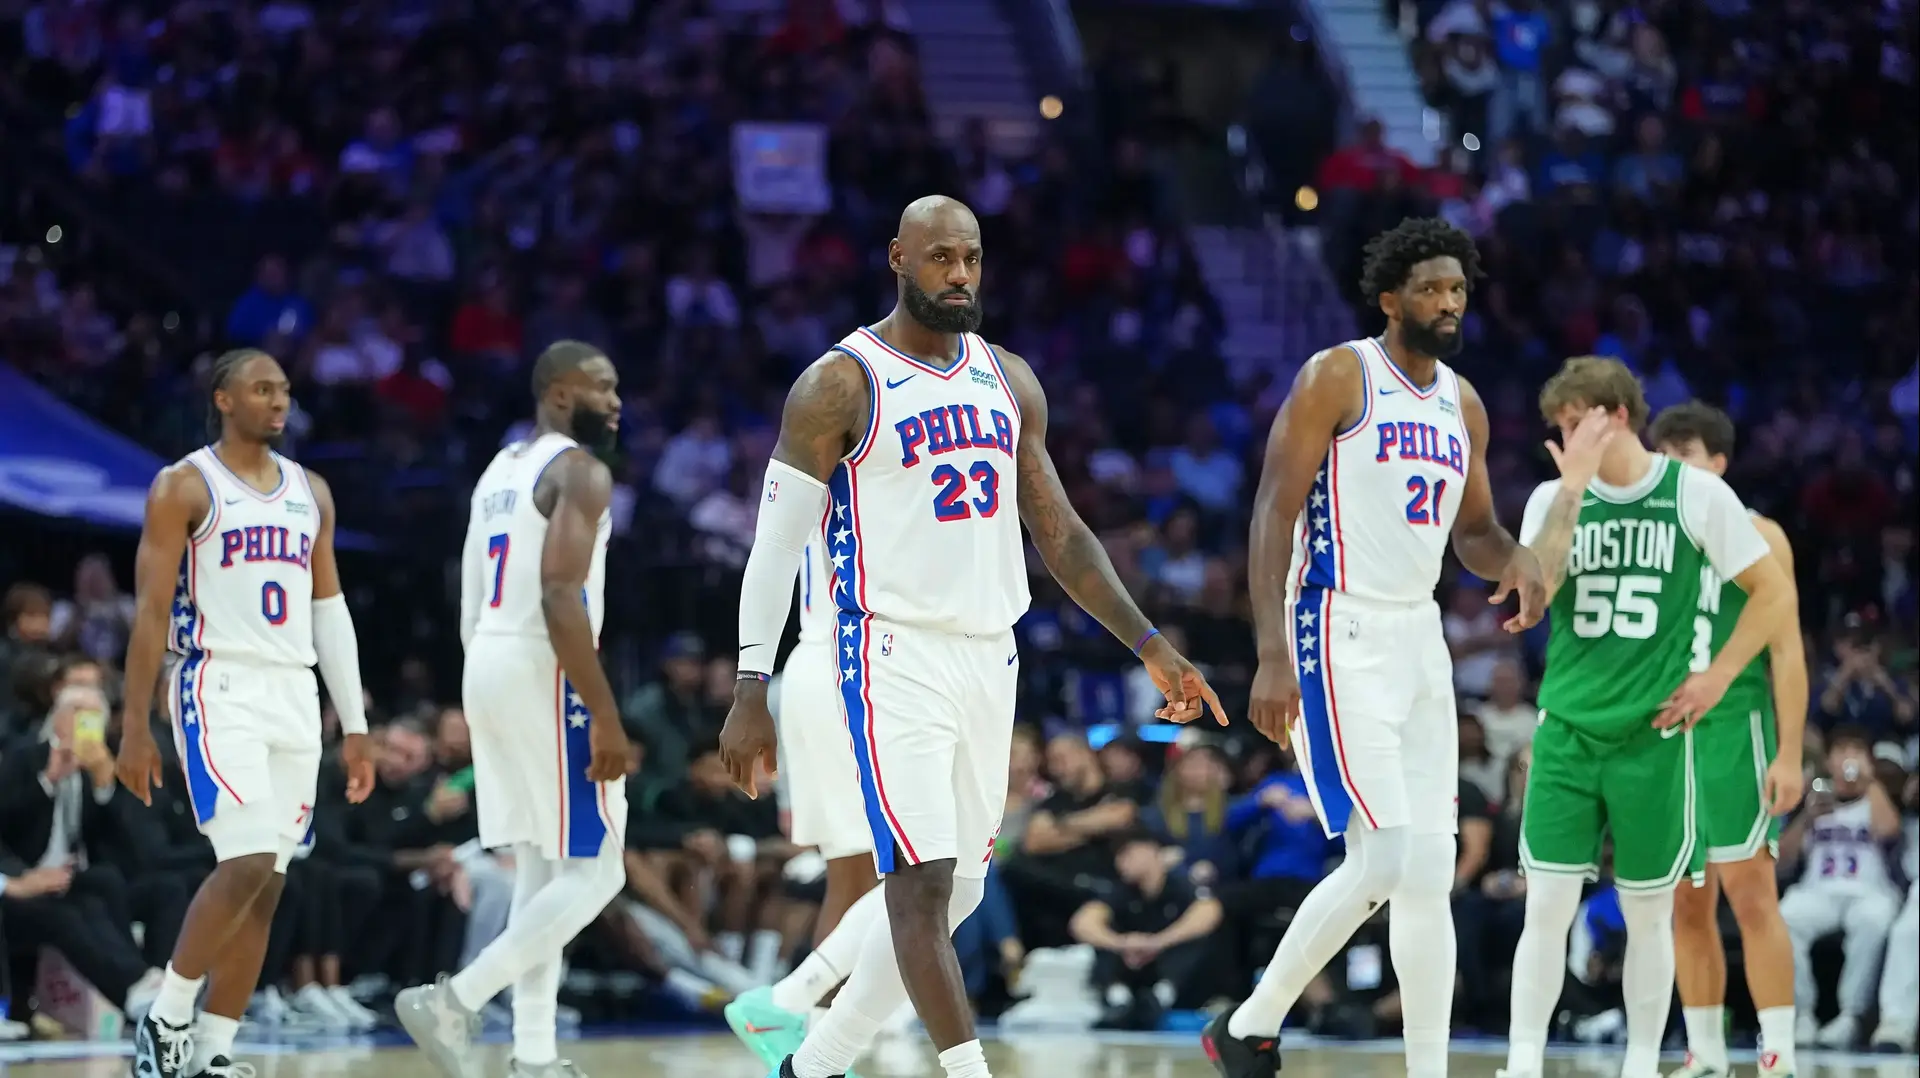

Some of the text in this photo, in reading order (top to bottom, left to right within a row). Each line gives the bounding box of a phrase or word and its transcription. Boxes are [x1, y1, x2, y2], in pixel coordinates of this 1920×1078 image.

[969, 366, 997, 381] Bloom
[972, 377, 998, 390] energy
[894, 404, 1014, 468] PHILA
[1376, 421, 1464, 477] PHILA
[931, 461, 999, 522] 23
[1406, 476, 1447, 527] 21
[220, 525, 311, 571] PHILA
[488, 533, 510, 608] 7
[1569, 518, 1677, 577] BOSTON
[262, 581, 288, 626] 0
[1573, 574, 1663, 640] 55
